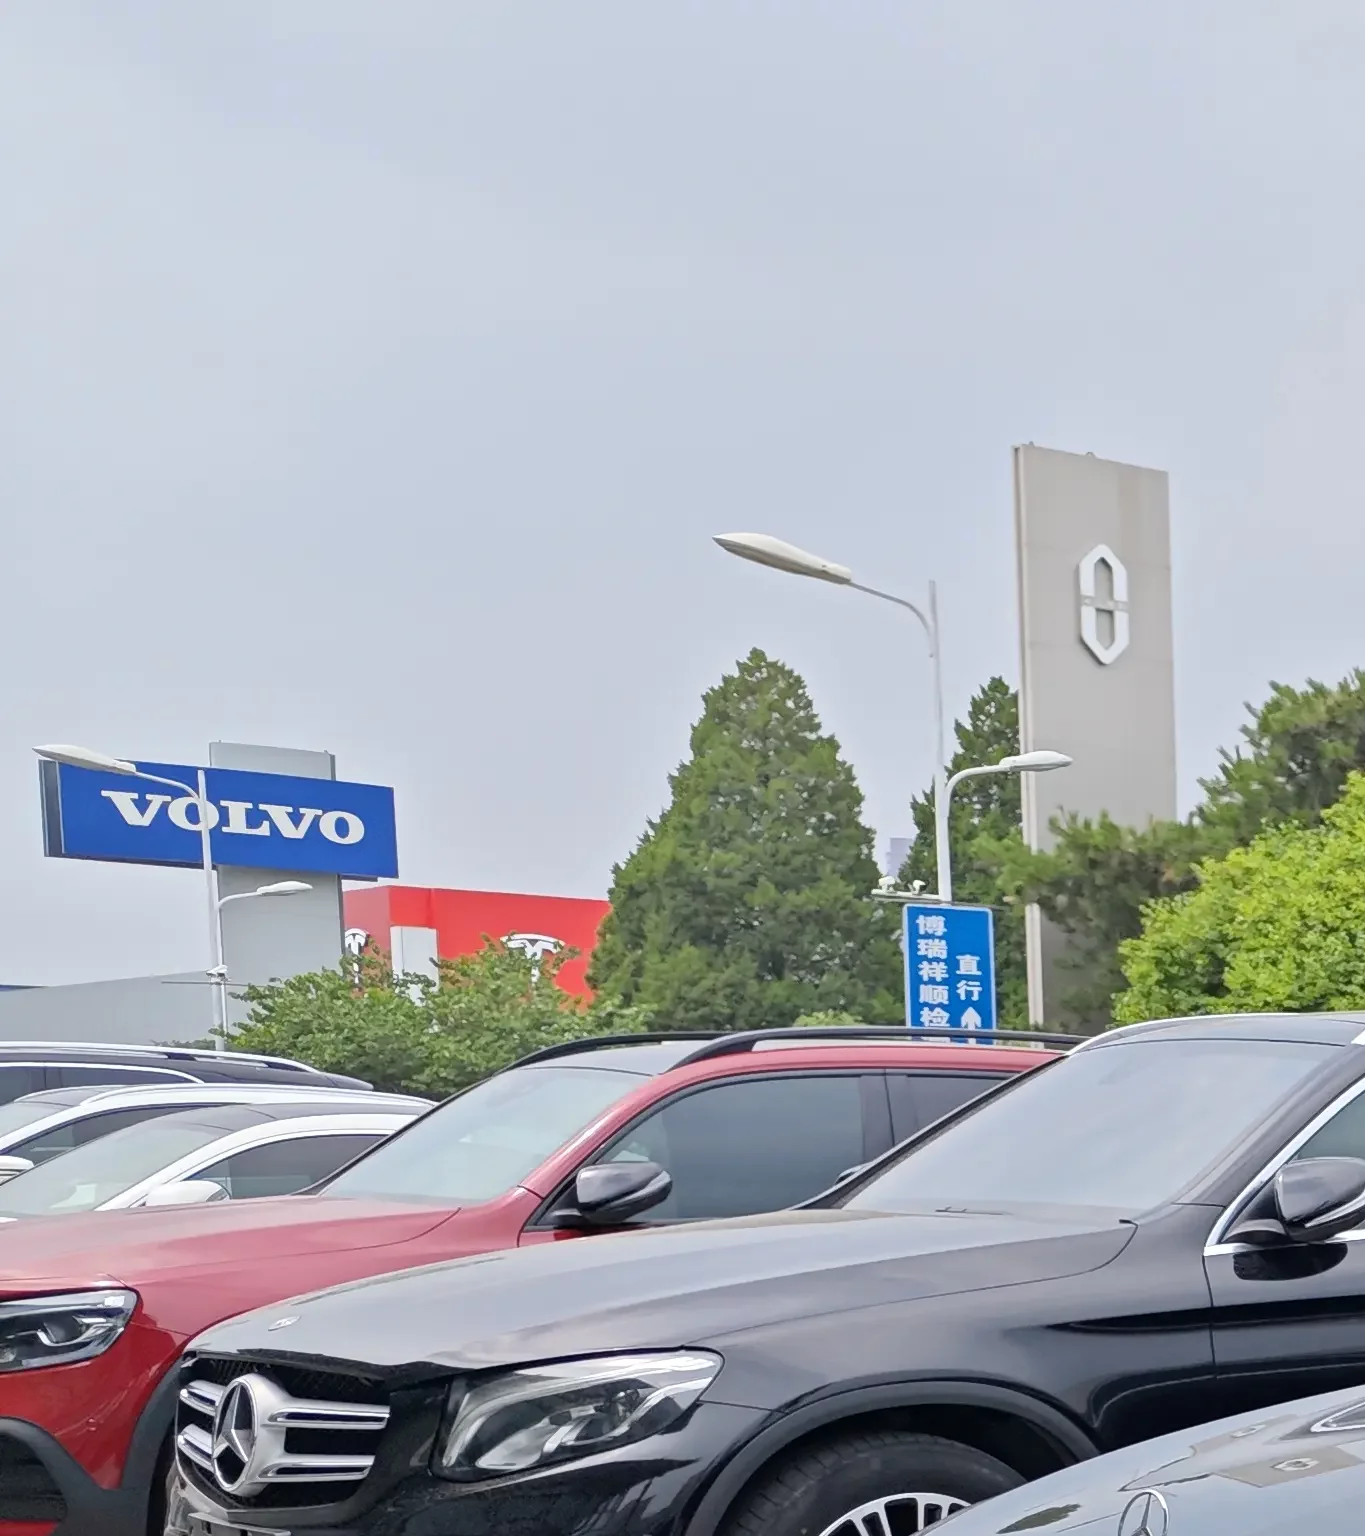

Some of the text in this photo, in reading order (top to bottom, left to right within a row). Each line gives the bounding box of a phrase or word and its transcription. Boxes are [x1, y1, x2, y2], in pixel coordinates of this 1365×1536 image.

[101, 789, 365, 845] VOLVO
[916, 914, 951, 1042] 博瑞祥顺检
[955, 954, 982, 1001] 直行
